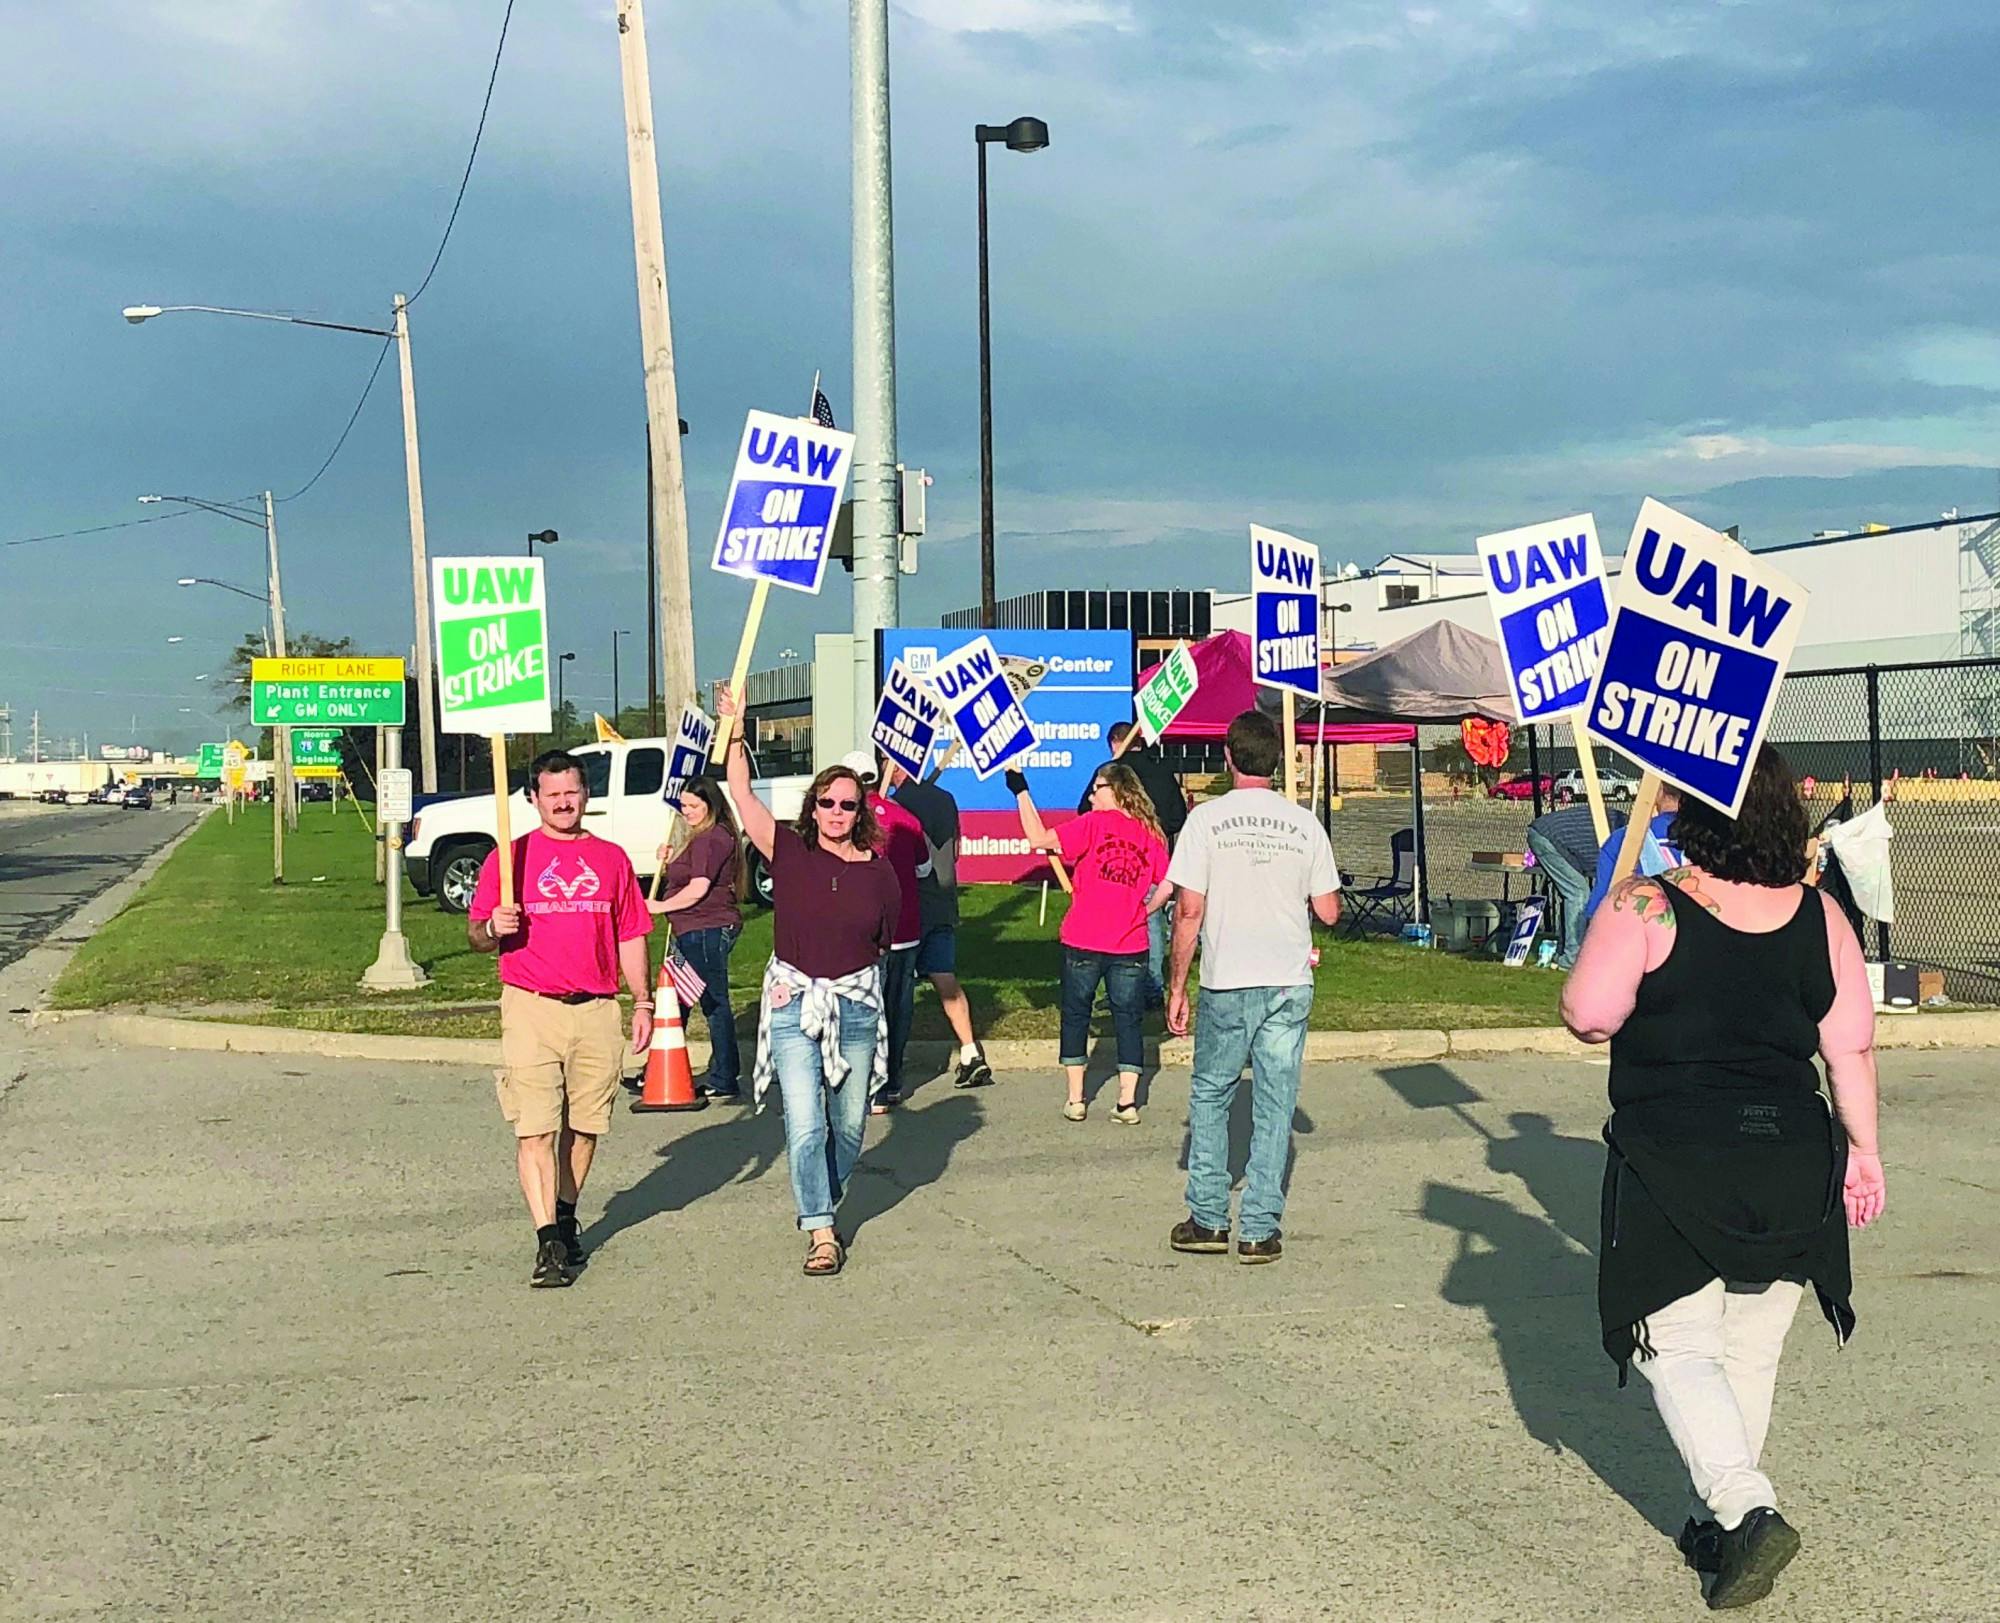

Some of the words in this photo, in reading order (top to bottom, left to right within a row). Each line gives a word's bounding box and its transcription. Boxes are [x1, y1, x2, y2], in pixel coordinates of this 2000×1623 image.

[747, 427, 843, 481] UAW
[761, 489, 804, 524] ON
[724, 526, 823, 563] STRIKE
[1488, 534, 1587, 594] UAW
[1257, 540, 1314, 590] UAW
[443, 567, 534, 605] UAW
[1635, 528, 1792, 649] UAW
[1276, 599, 1300, 634] ON
[1536, 597, 1578, 652] ON
[468, 617, 507, 661] ON
[1259, 634, 1316, 674] STRIKE
[281, 663, 326, 676] RIGHT
[337, 663, 376, 676] LANE
[445, 643, 544, 708] STRIKE
[910, 653, 932, 670] GM
[936, 648, 995, 700] UAW
[1049, 655, 1113, 672] Center
[1170, 648, 1193, 695] UAW
[1518, 626, 1606, 711] STRIK
[1655, 641, 1721, 700] ON
[266, 684, 309, 699] Plant
[319, 684, 392, 699] Entrance
[891, 669, 940, 723] UAW
[1141, 688, 1172, 723] STRIKE
[1156, 678, 1173, 699] ON
[295, 703, 318, 717] GM
[327, 703, 368, 717] ONLY
[893, 711, 917, 738] ON
[972, 690, 1000, 729] ON
[1598, 681, 1750, 766] STRIKE
[682, 710, 710, 751] UAW
[874, 721, 926, 765] STRIKE
[972, 702, 1026, 769] STRIKE
[1031, 721, 1100, 739] ntrance
[295, 755, 337, 765] Saginaw
[681, 753, 697, 776] ON
[1016, 750, 1073, 768] trance
[960, 835, 1031, 856] bulance
